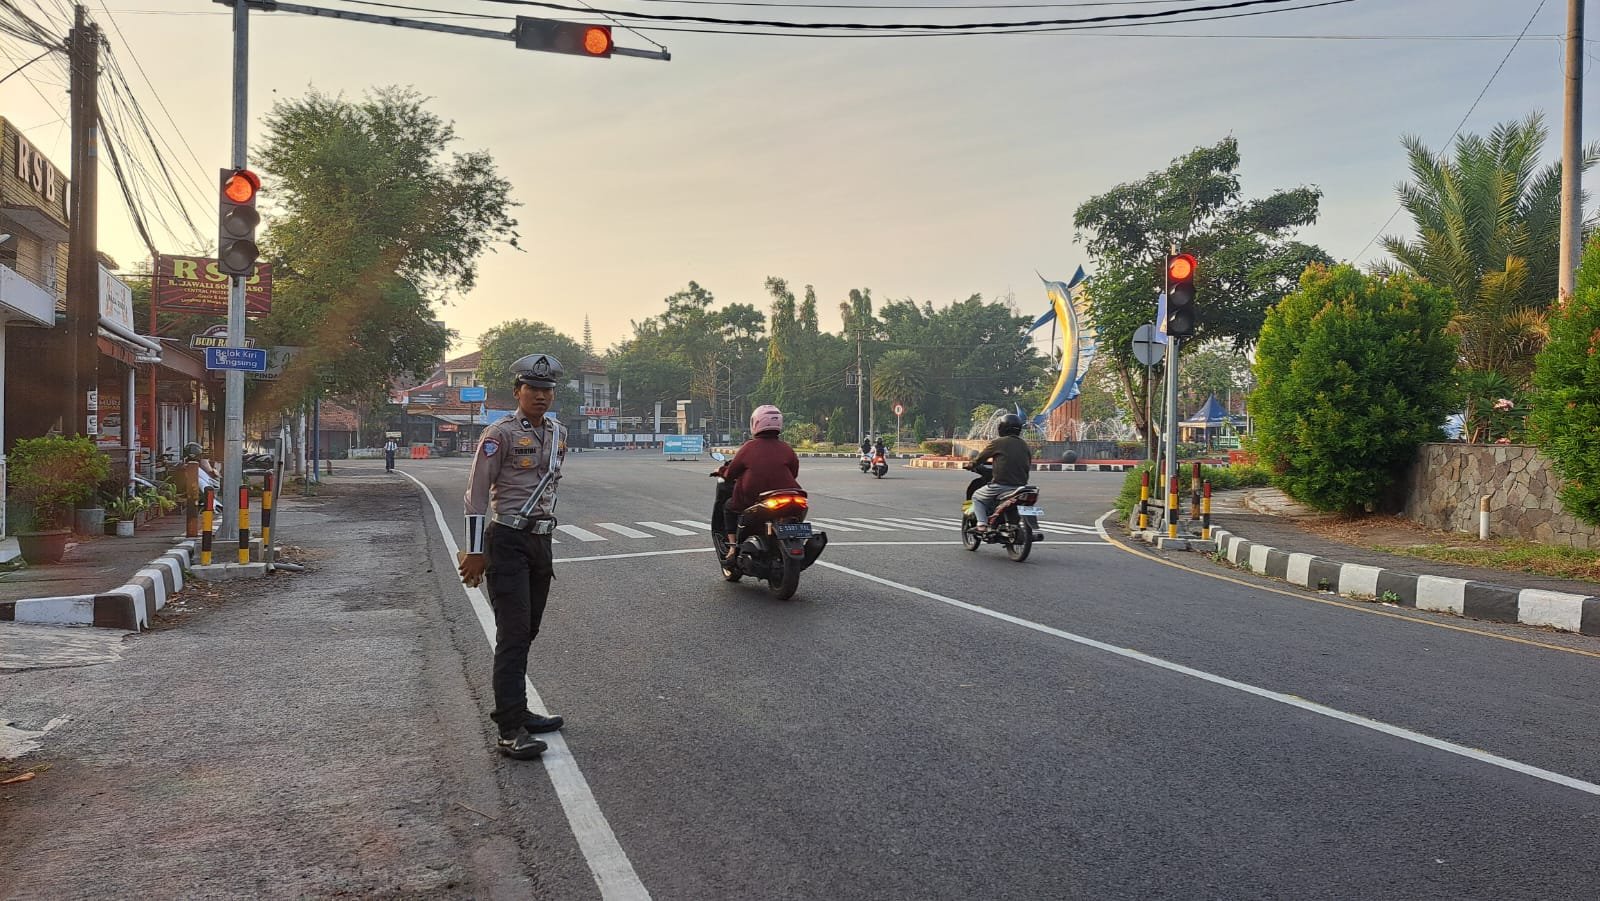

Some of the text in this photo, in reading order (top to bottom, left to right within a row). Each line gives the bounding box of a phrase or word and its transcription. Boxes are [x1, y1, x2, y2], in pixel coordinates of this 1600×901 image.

[15, 135, 55, 202] RSB
[195, 337, 215, 346] BUDI
[215, 349, 257, 359] Belok Kiri
[215, 357, 258, 368] Langsung
